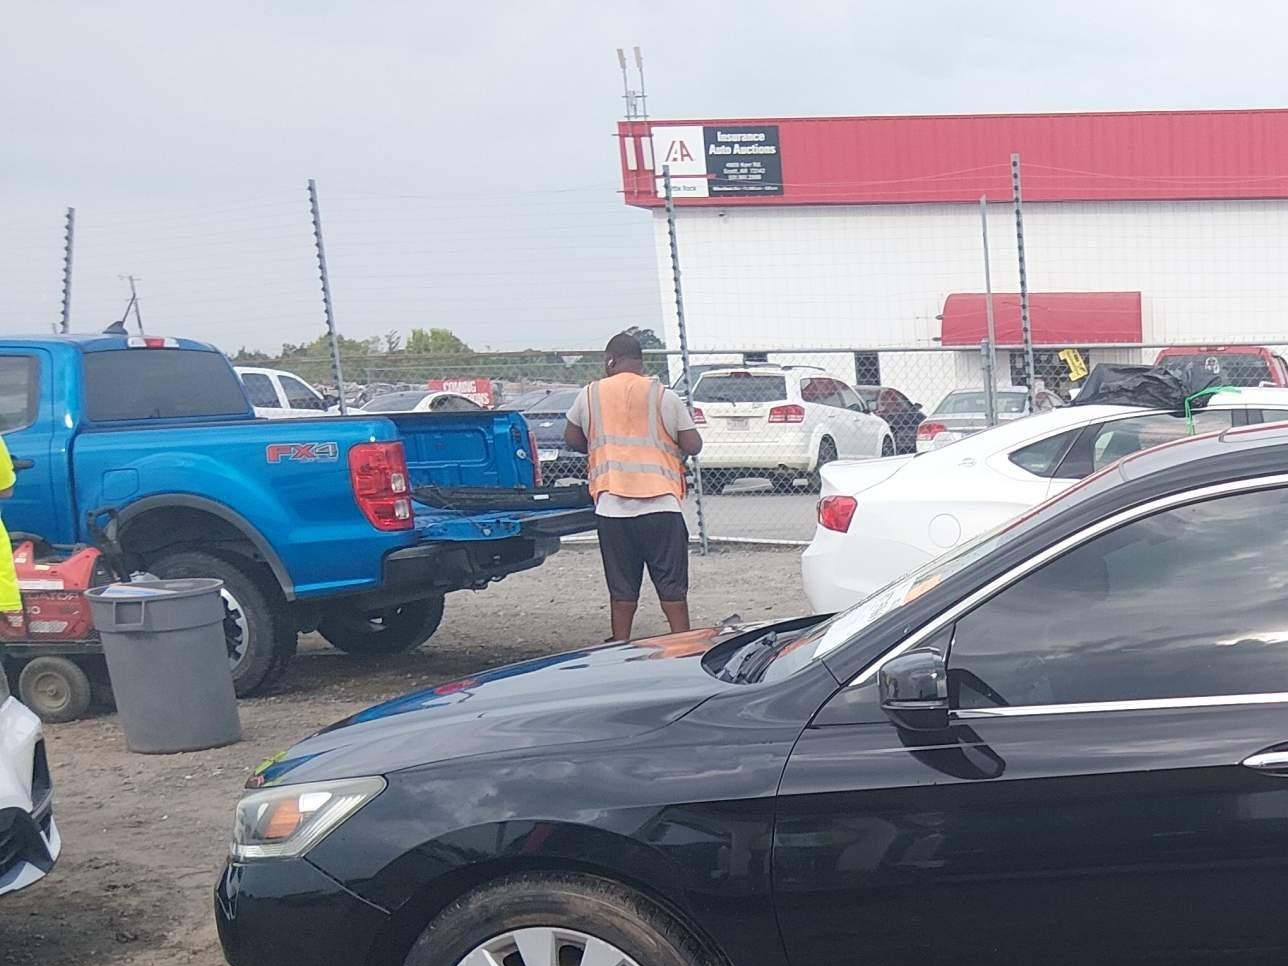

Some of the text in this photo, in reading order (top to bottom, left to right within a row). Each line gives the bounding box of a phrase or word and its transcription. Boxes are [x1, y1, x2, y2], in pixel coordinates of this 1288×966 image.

[717, 131, 765, 142] Insurance
[708, 143, 777, 154] Auto Auctions
[266, 441, 339, 464] FX4
